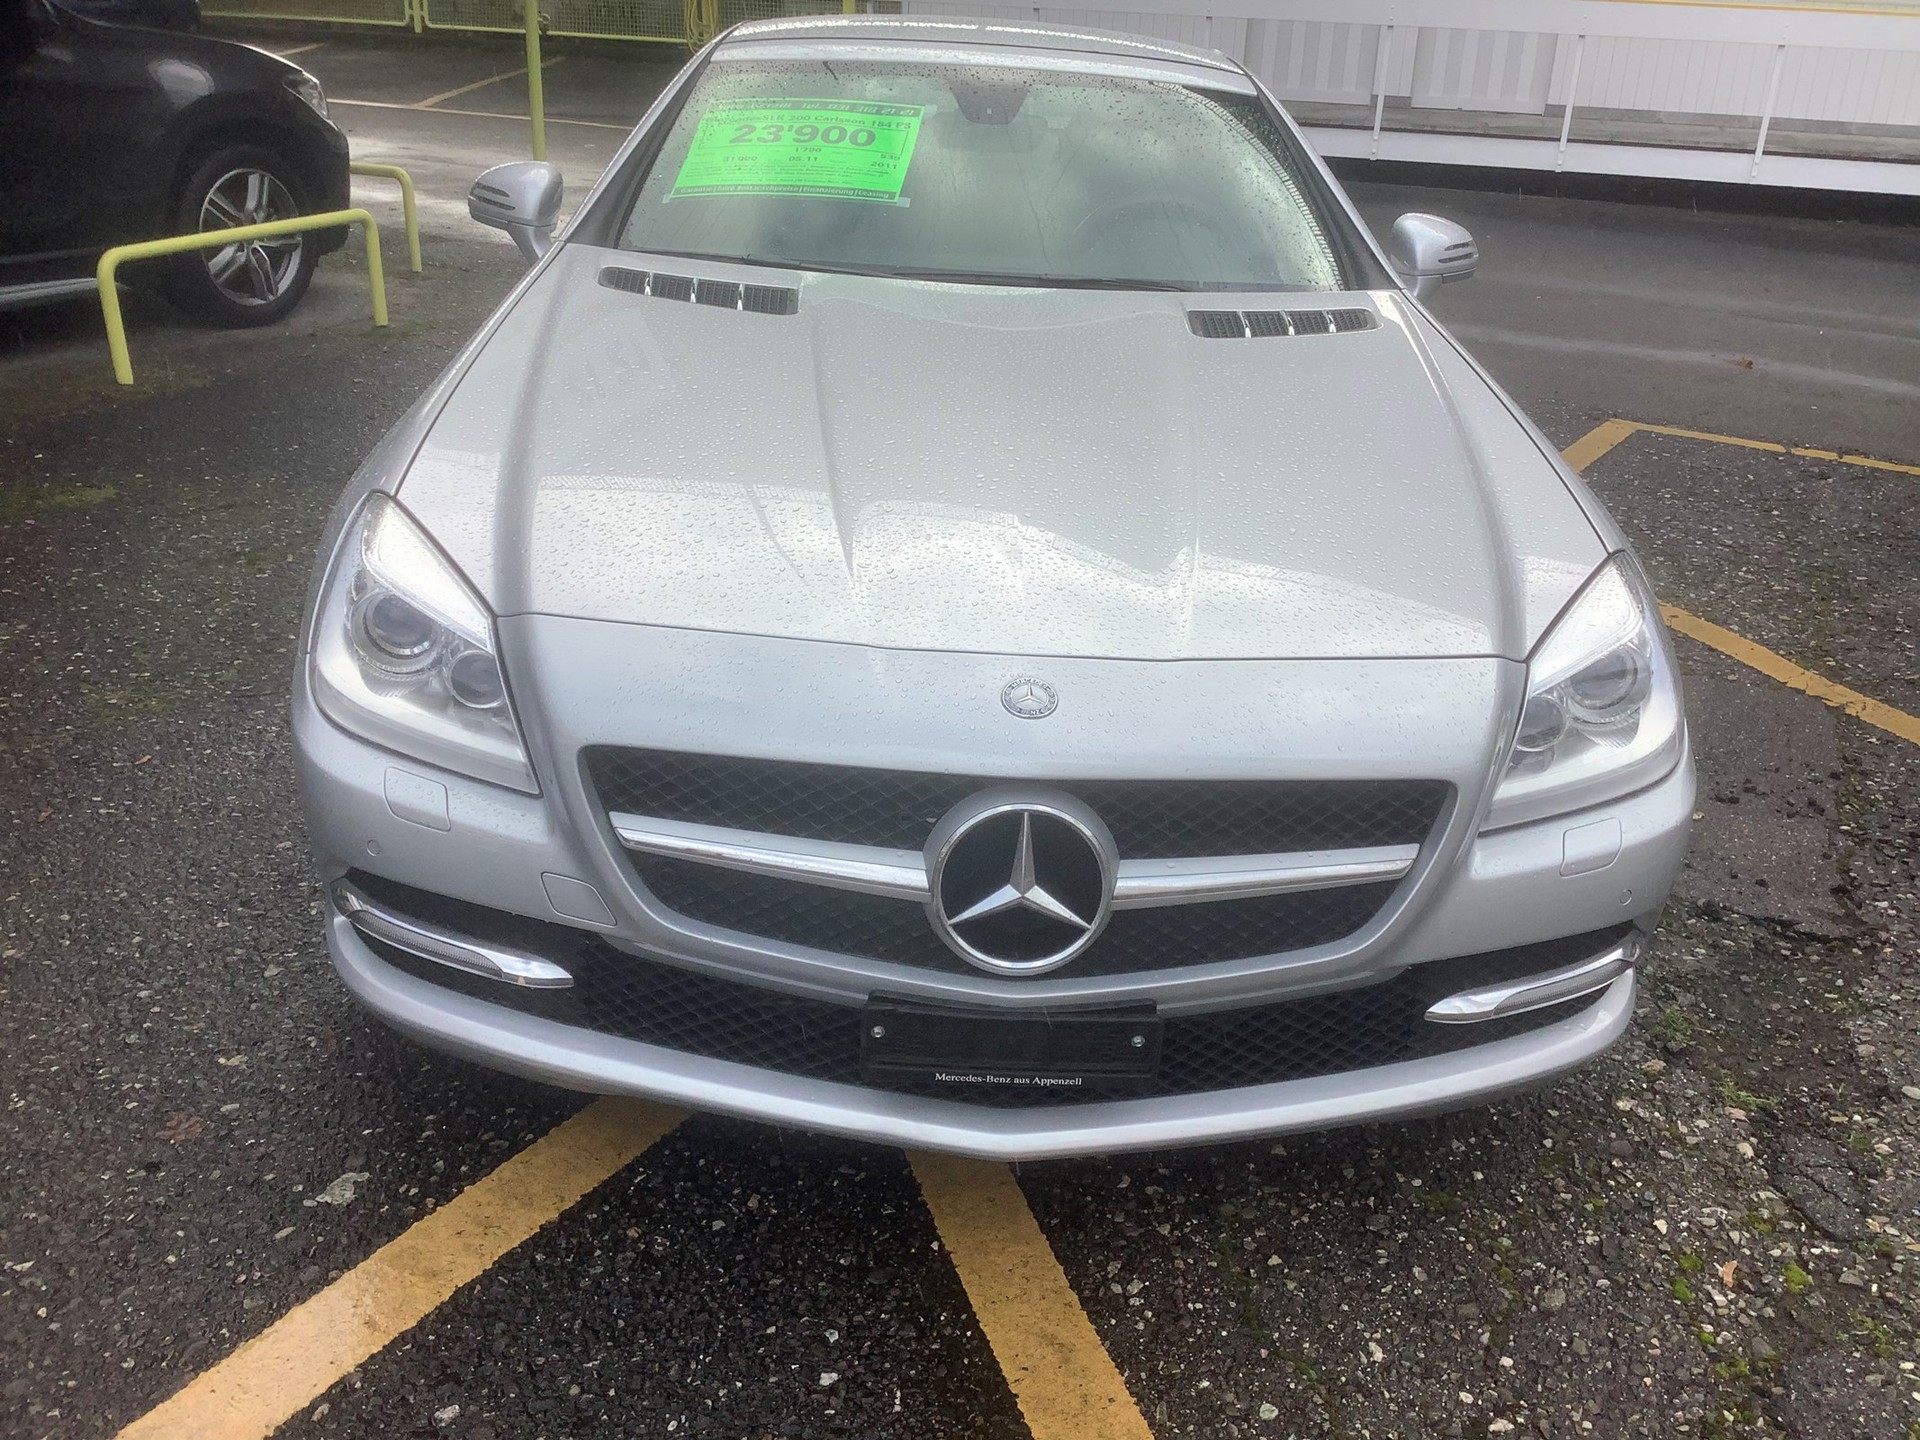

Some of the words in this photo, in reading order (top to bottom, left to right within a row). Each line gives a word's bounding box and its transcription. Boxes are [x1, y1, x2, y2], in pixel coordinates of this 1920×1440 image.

[814, 115, 866, 126] Carlsson
[871, 120, 892, 129] 184
[728, 124, 877, 147] 23'900
[870, 160, 898, 170] 2011
[934, 1072, 1012, 1084] Mercedes-Benz
[1013, 1077, 1030, 1085] aus
[1031, 1076, 1083, 1087] Appenzell
